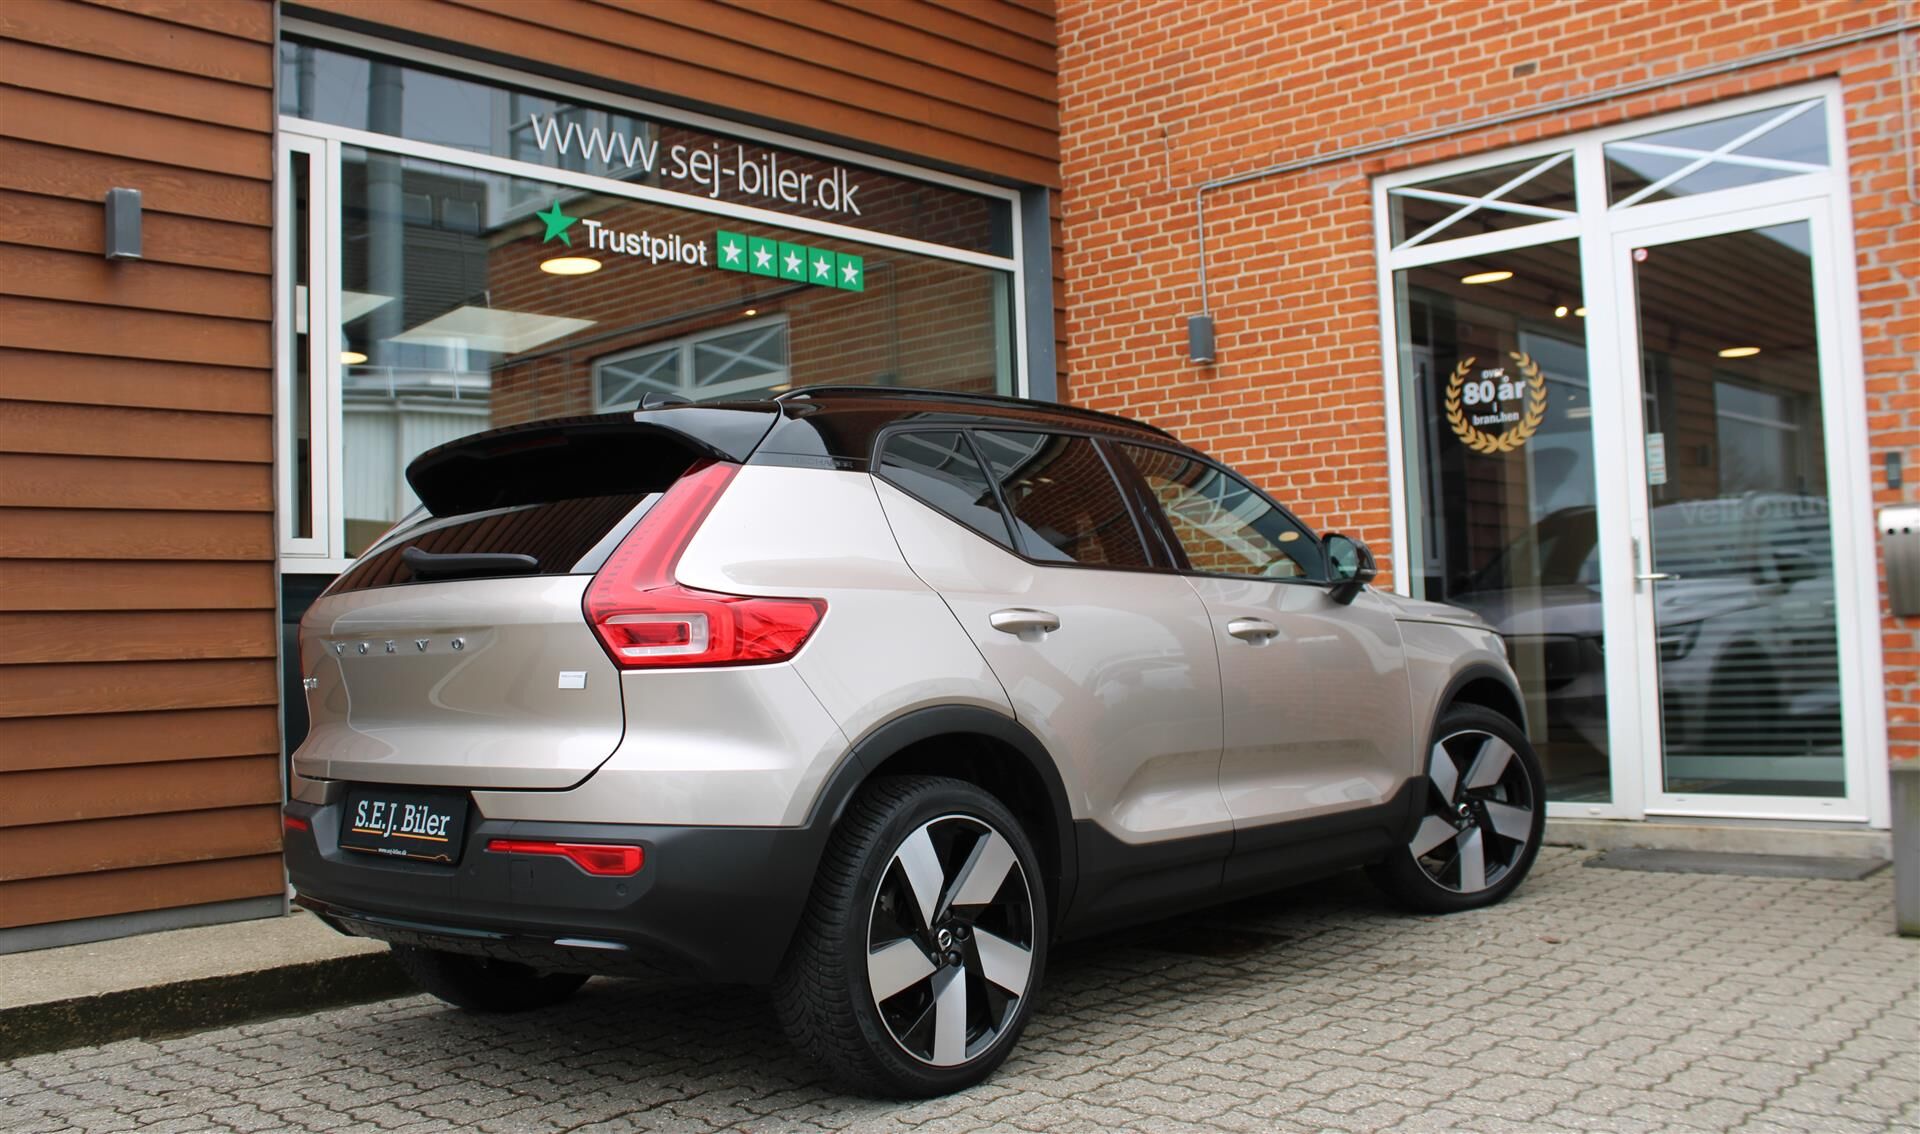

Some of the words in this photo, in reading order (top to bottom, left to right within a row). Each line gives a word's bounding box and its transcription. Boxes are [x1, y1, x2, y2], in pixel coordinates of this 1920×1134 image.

[531, 113, 861, 216] www.sej-biler.dk
[582, 219, 708, 266] Trustpilot
[1463, 380, 1495, 404] 80
[1498, 376, 1526, 400] år
[335, 637, 465, 655] VOLVO
[355, 800, 397, 837] S.E.J.
[401, 804, 450, 835] Biler
